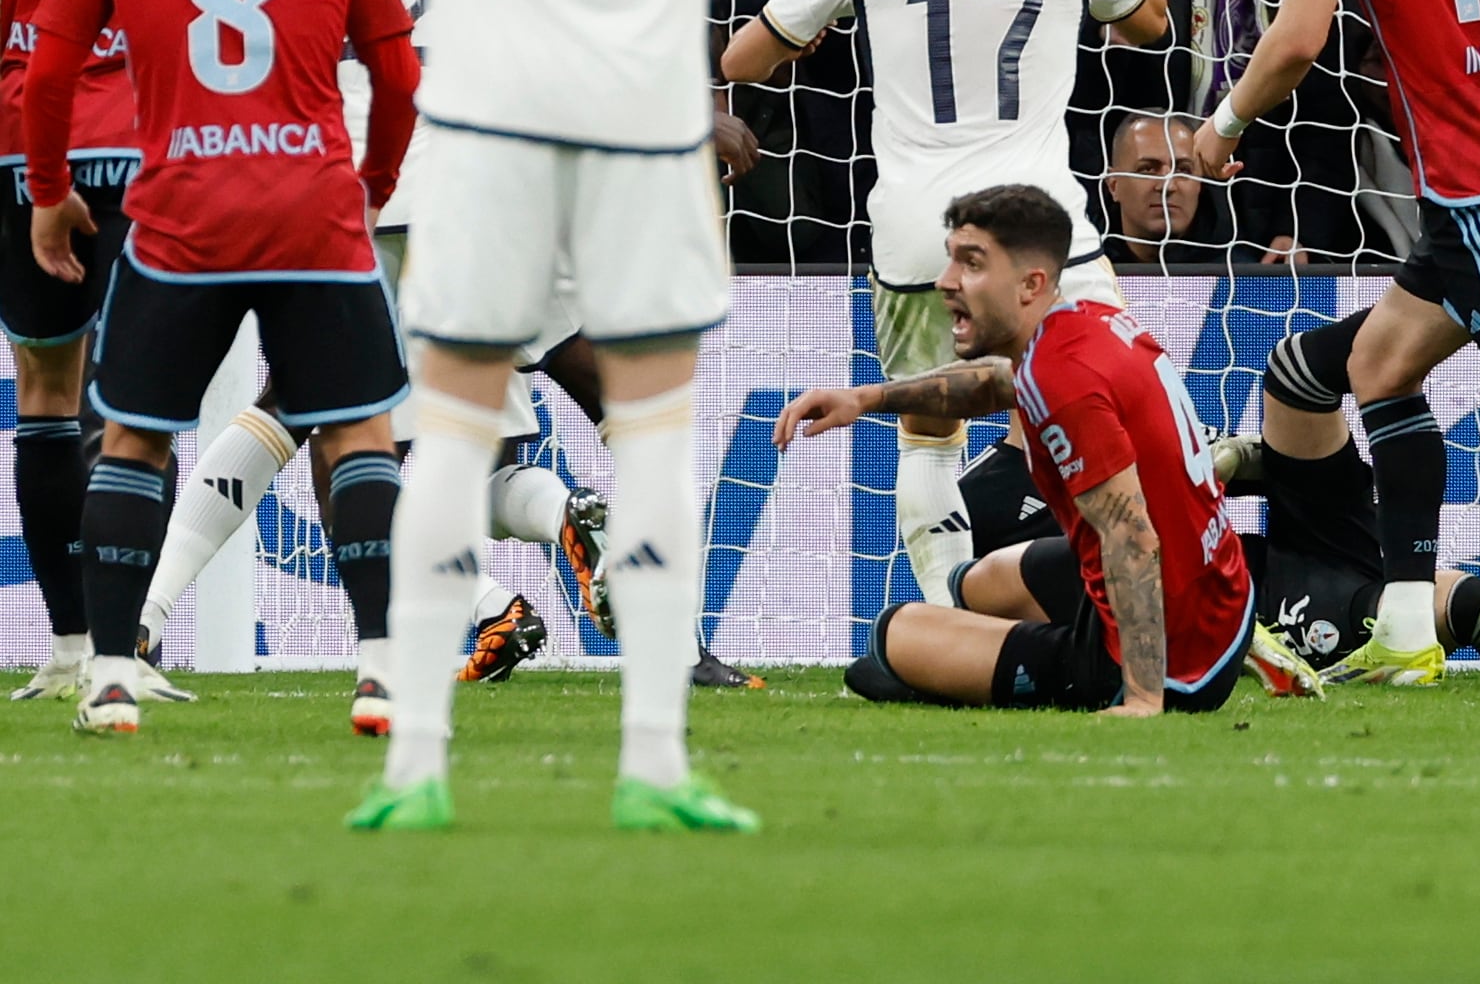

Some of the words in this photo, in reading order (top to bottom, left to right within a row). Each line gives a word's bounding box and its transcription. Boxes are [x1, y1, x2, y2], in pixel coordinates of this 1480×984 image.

[167, 123, 326, 159] ABANCA
[1153, 352, 1218, 498] 4
[337, 539, 391, 561] 2023
